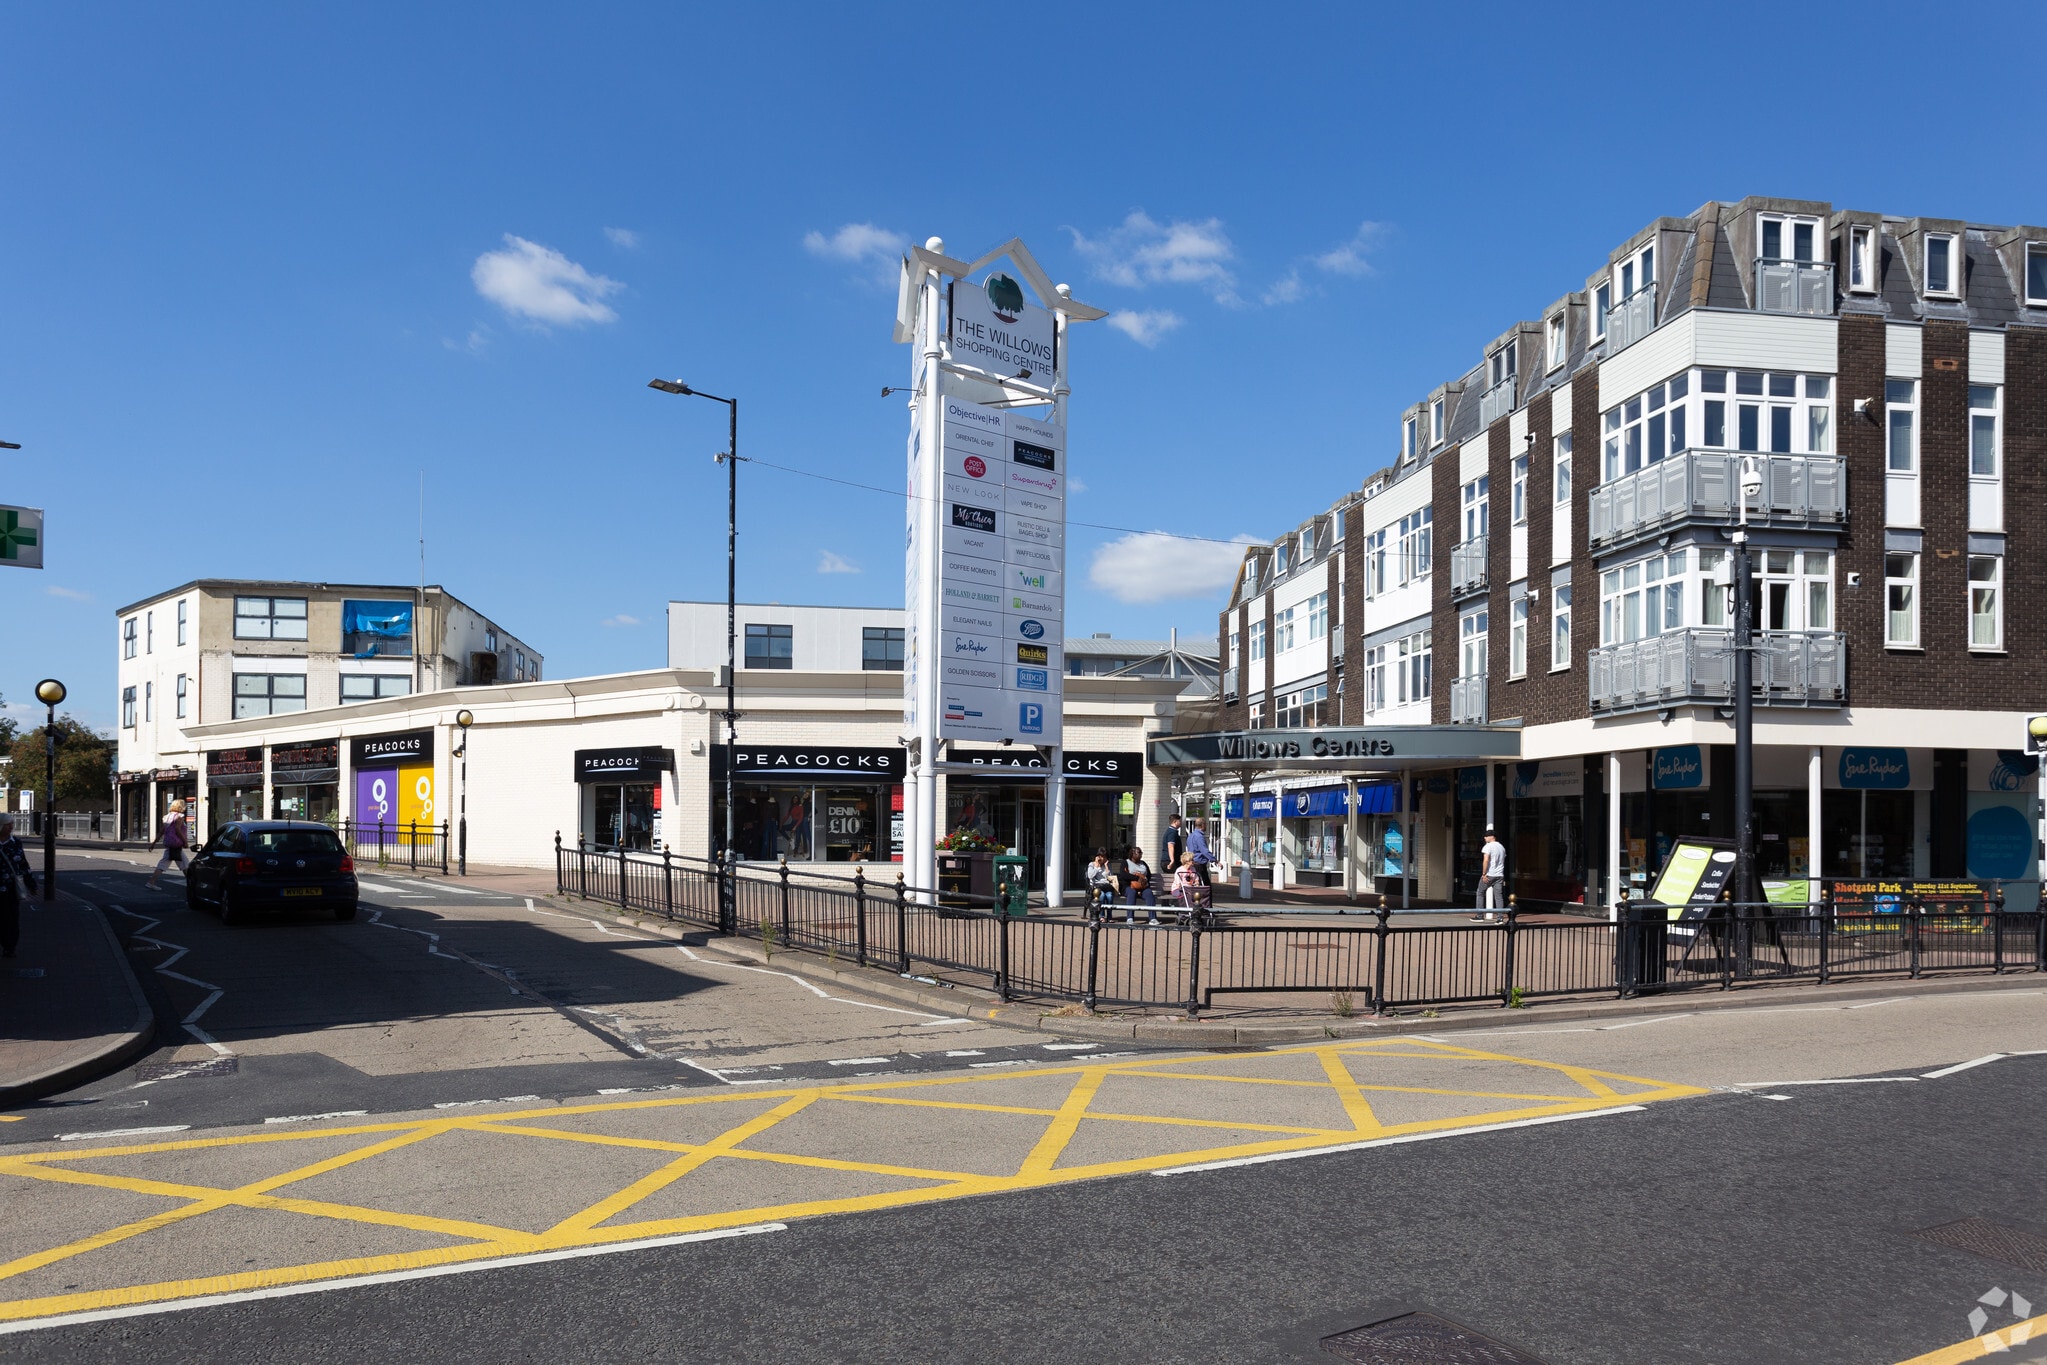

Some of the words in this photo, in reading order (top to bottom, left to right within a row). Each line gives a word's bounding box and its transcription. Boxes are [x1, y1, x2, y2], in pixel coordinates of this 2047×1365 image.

[956, 317, 984, 339] THE
[989, 328, 1051, 361] WILLOWS
[956, 337, 1010, 362] SHOPPING
[1013, 355, 1051, 376] CENTRE
[1016, 424, 1032, 433] HAPPY
[1033, 428, 1053, 439] HOUNDS
[955, 433, 980, 445] ORIENTAL
[980, 439, 994, 447] CHEF
[965, 465, 984, 474] OFFICE
[968, 460, 982, 468] POST
[1012, 473, 1053, 490] Superdrug
[947, 483, 970, 494] NEW
[974, 489, 1000, 500] LOOK
[1020, 500, 1033, 508] VAPE
[1034, 532, 1048, 540] SHOP
[963, 539, 984, 548] VACANT
[949, 562, 969, 572] COFFEE
[970, 566, 997, 577] MOMENTS
[1022, 575, 1045, 588] well
[945, 588, 970, 599] HOLLAND
[953, 616, 976, 625] ELEGANT
[977, 619, 992, 627] NAILS
[955, 637, 969, 652] Sue
[969, 639, 988, 656] Ryder
[947, 667, 970, 676] GOLDEN
[970, 670, 997, 678] SCISSORS
[1021, 672, 1044, 682] RIDGE
[1026, 706, 1039, 724] P
[365, 739, 421, 753] PEACOCKS
[1217, 737, 1299, 757] Willows
[1311, 736, 1395, 757] Centre
[736, 754, 890, 767] PEACOCKS
[973, 758, 1118, 771] PEACCKS
[1845, 753, 1868, 778] Sue
[1868, 755, 1903, 781] Ryder
[1657, 757, 1673, 779] Sue
[1673, 757, 1698, 780] Ryder
[828, 806, 860, 816] DENIM
[828, 816, 860, 834] £10
[1834, 882, 1876, 895] Shotgate
[1878, 882, 1902, 893] Park
